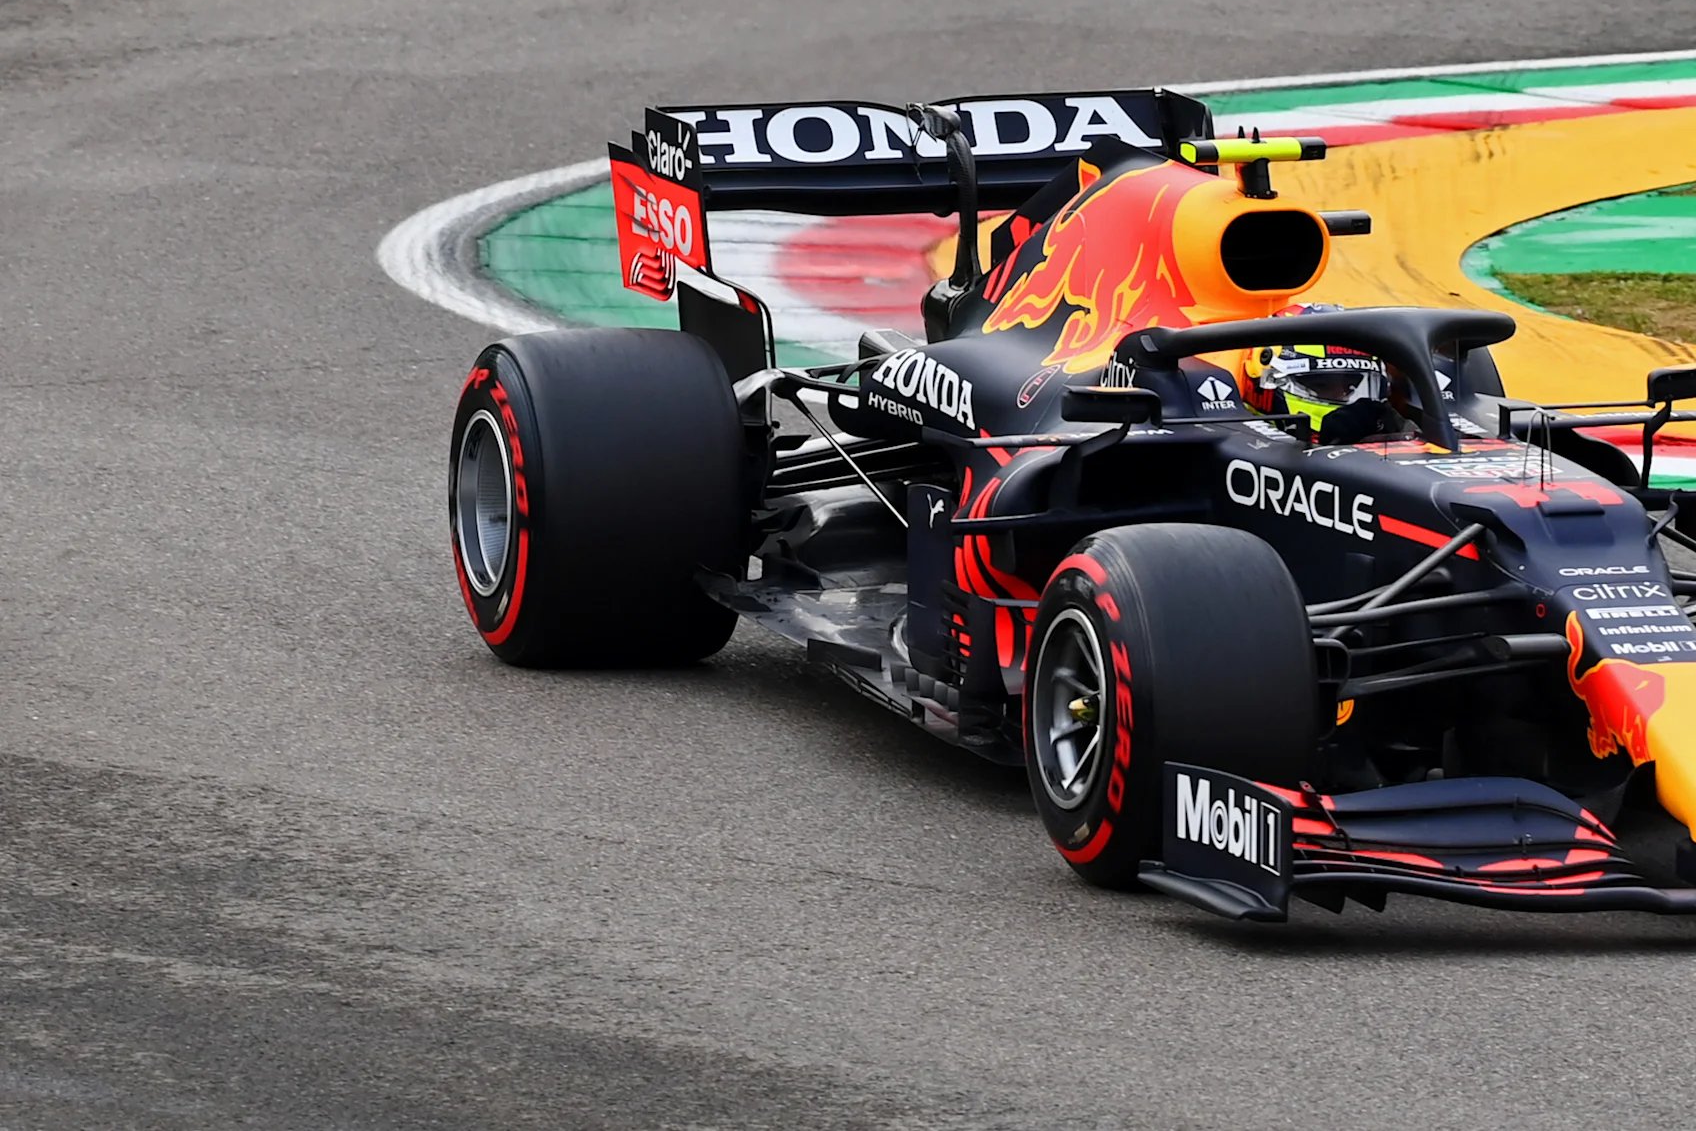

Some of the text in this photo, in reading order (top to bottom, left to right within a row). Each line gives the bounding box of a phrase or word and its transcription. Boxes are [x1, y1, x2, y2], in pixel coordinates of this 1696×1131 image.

[668, 96, 1163, 164] HONDA
[648, 129, 686, 181] Claro
[631, 186, 692, 257] ESSO
[1316, 358, 1380, 372] HONDA
[868, 391, 924, 426] HYBRID
[872, 348, 976, 431] HONDA
[1202, 400, 1238, 411] INTER
[1225, 459, 1375, 541] ORACLE
[1558, 565, 1651, 577] ORACLE
[1572, 581, 1668, 601] citrix
[1585, 605, 1680, 620] PIRELLI
[1610, 641, 1681, 655] Mobil
[1106, 640, 1135, 814] ZERO
[1176, 772, 1258, 864] Mobil
